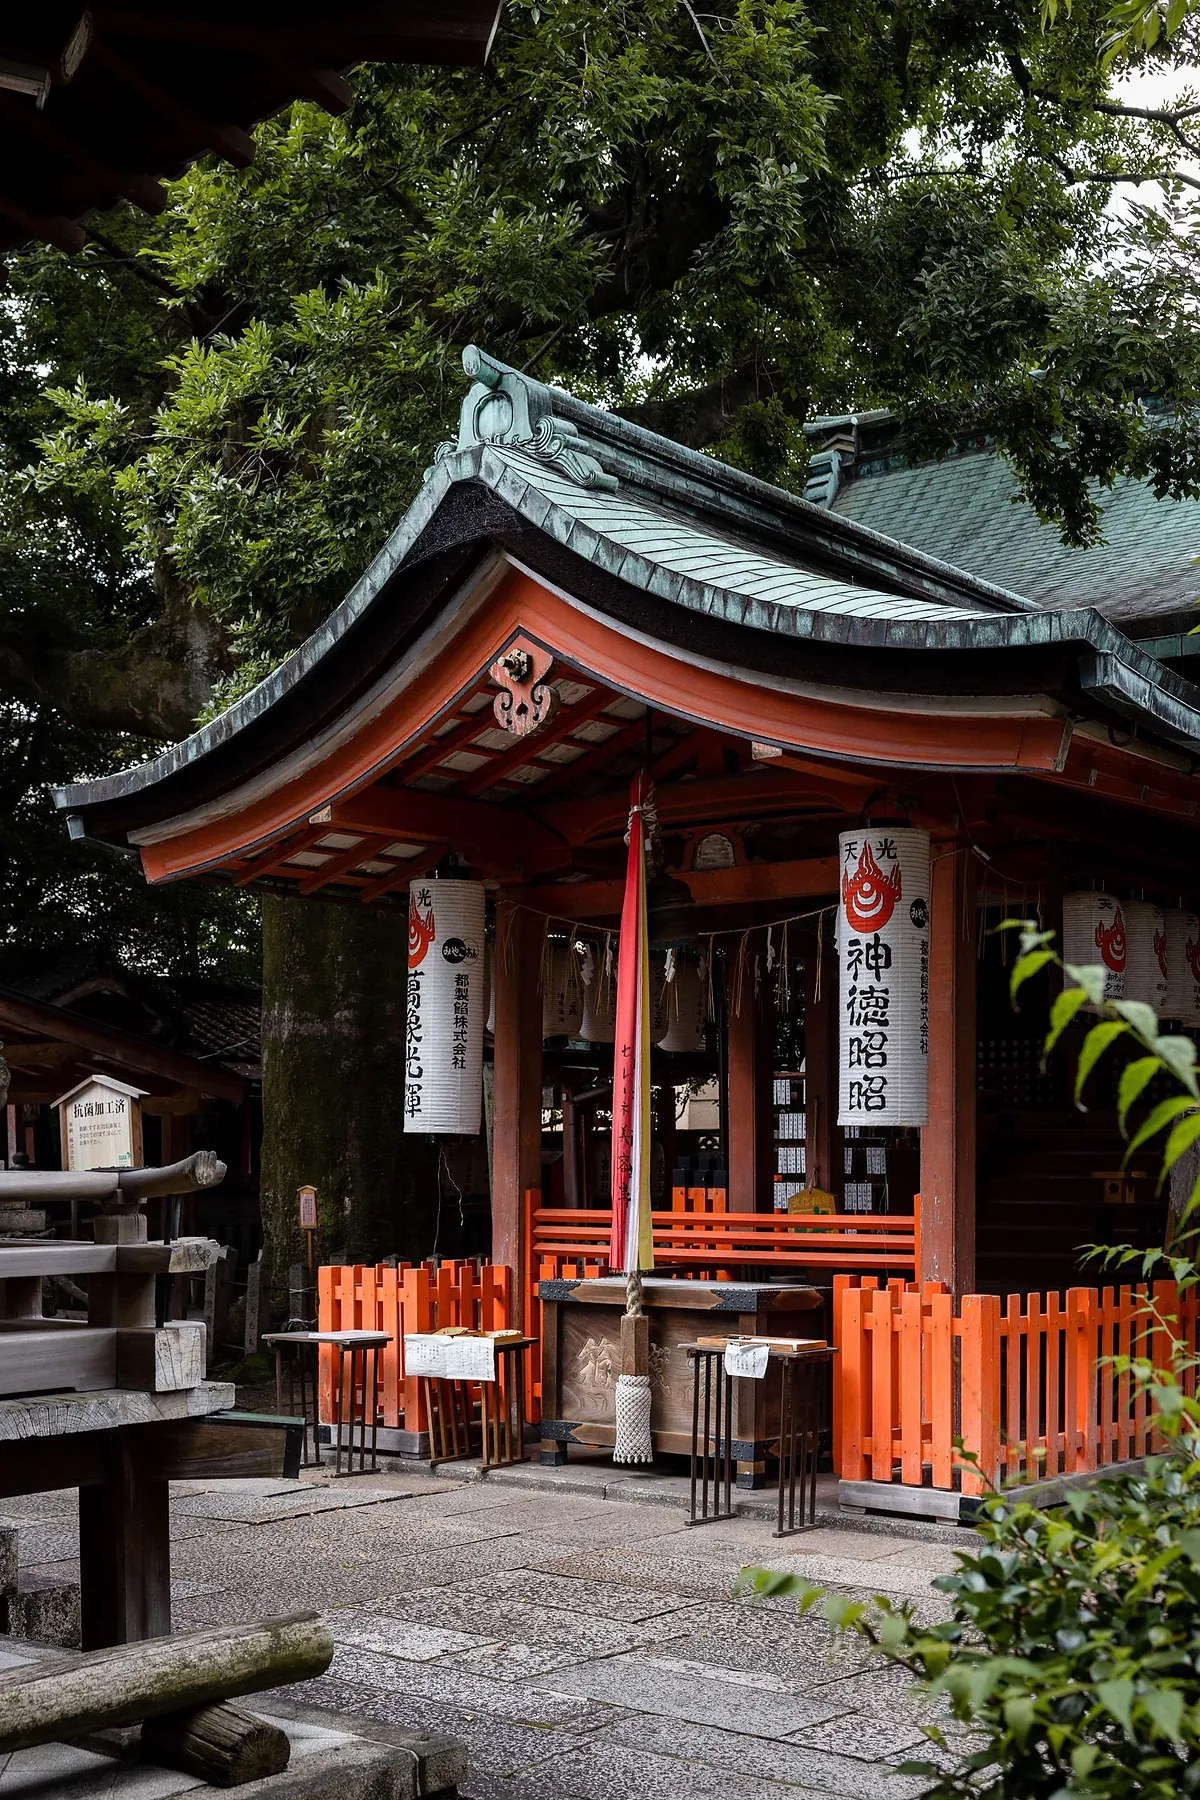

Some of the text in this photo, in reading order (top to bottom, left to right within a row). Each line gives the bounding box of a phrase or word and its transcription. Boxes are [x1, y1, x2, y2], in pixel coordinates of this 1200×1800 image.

[844, 838, 898, 863] 天 光
[417, 888, 432, 908] 光
[451, 973, 470, 1070] 都製餡株式会社
[847, 933, 892, 1112] 神徳昭昭
[73, 1099, 125, 1118] 抗菌加工済
